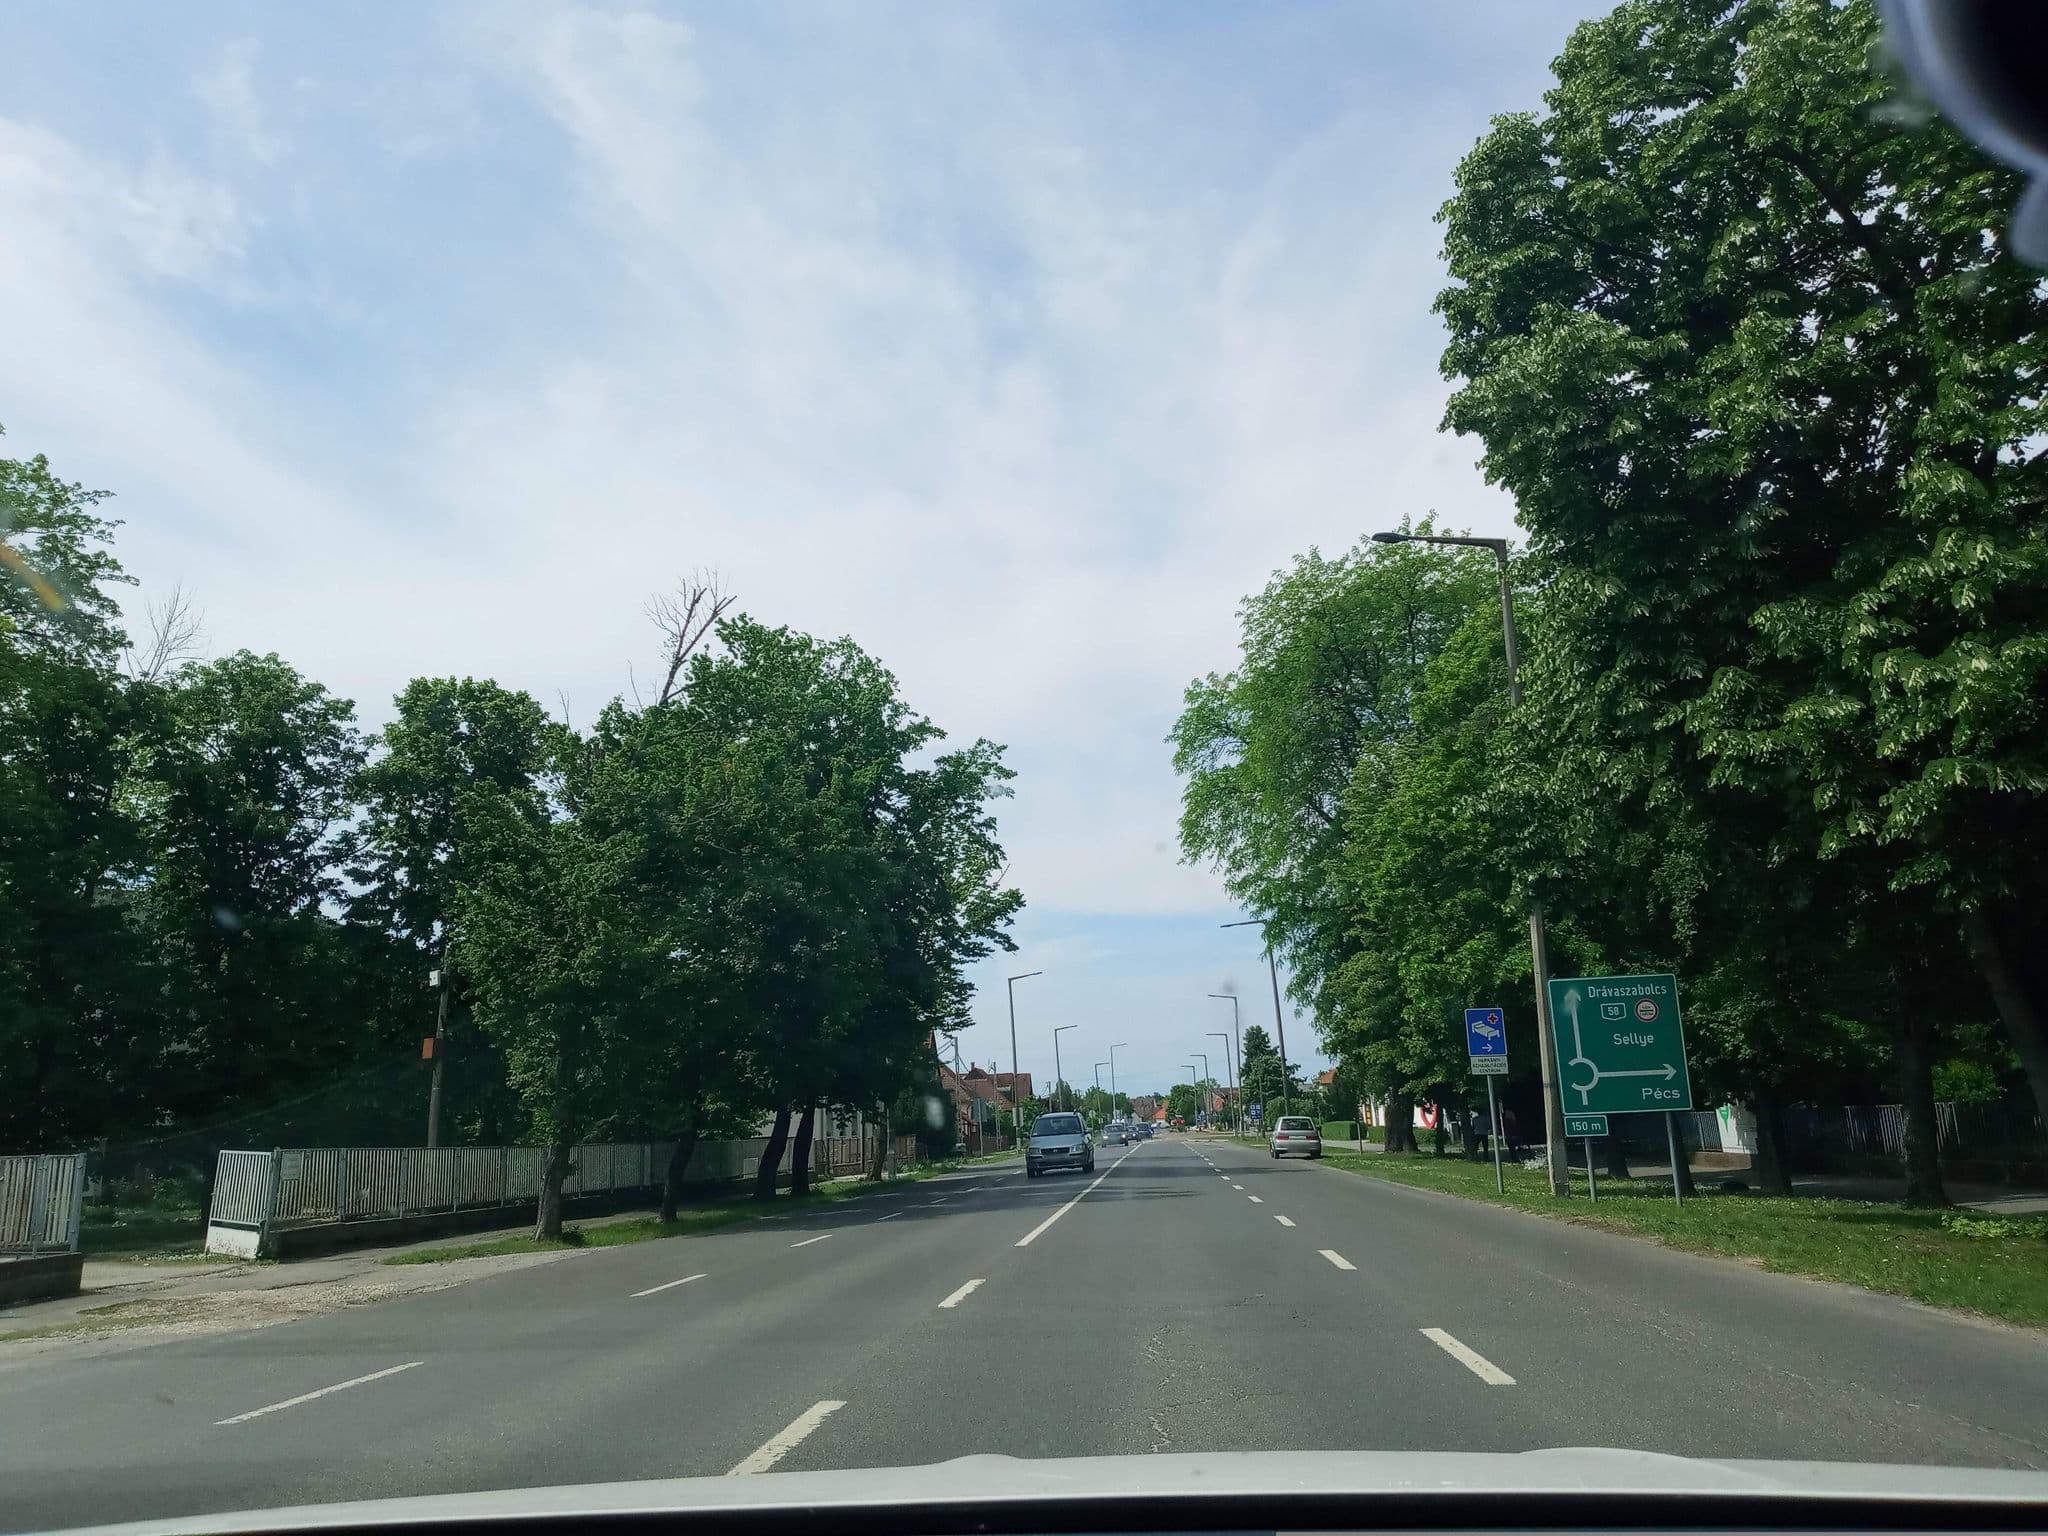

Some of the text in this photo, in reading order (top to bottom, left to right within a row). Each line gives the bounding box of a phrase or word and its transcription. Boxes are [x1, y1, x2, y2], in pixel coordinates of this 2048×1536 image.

[1588, 984, 1667, 998] Drávaszabolcs
[1607, 1006, 1619, 1016] 58
[1613, 1033, 1654, 1047] Sellye
[1642, 1087, 1681, 1100] Pécs
[1571, 1121, 1601, 1131] 150 m
